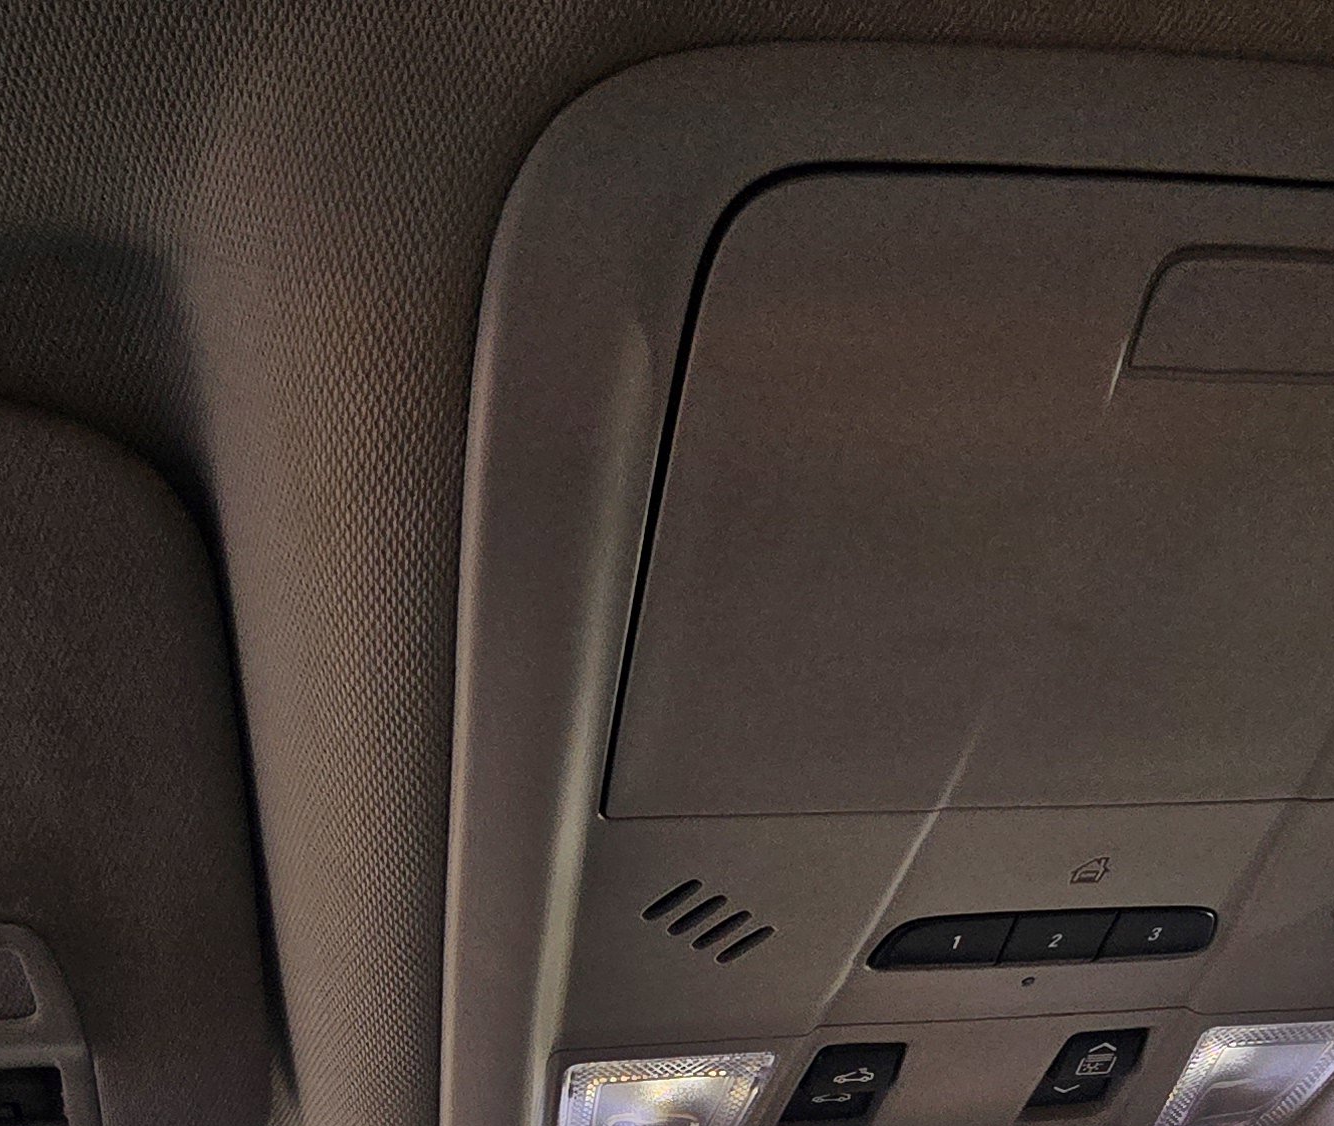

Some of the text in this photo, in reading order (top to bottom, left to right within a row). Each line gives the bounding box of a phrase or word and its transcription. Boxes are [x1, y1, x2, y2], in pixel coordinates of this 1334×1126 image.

[951, 927, 1162, 950] 1 2 3
